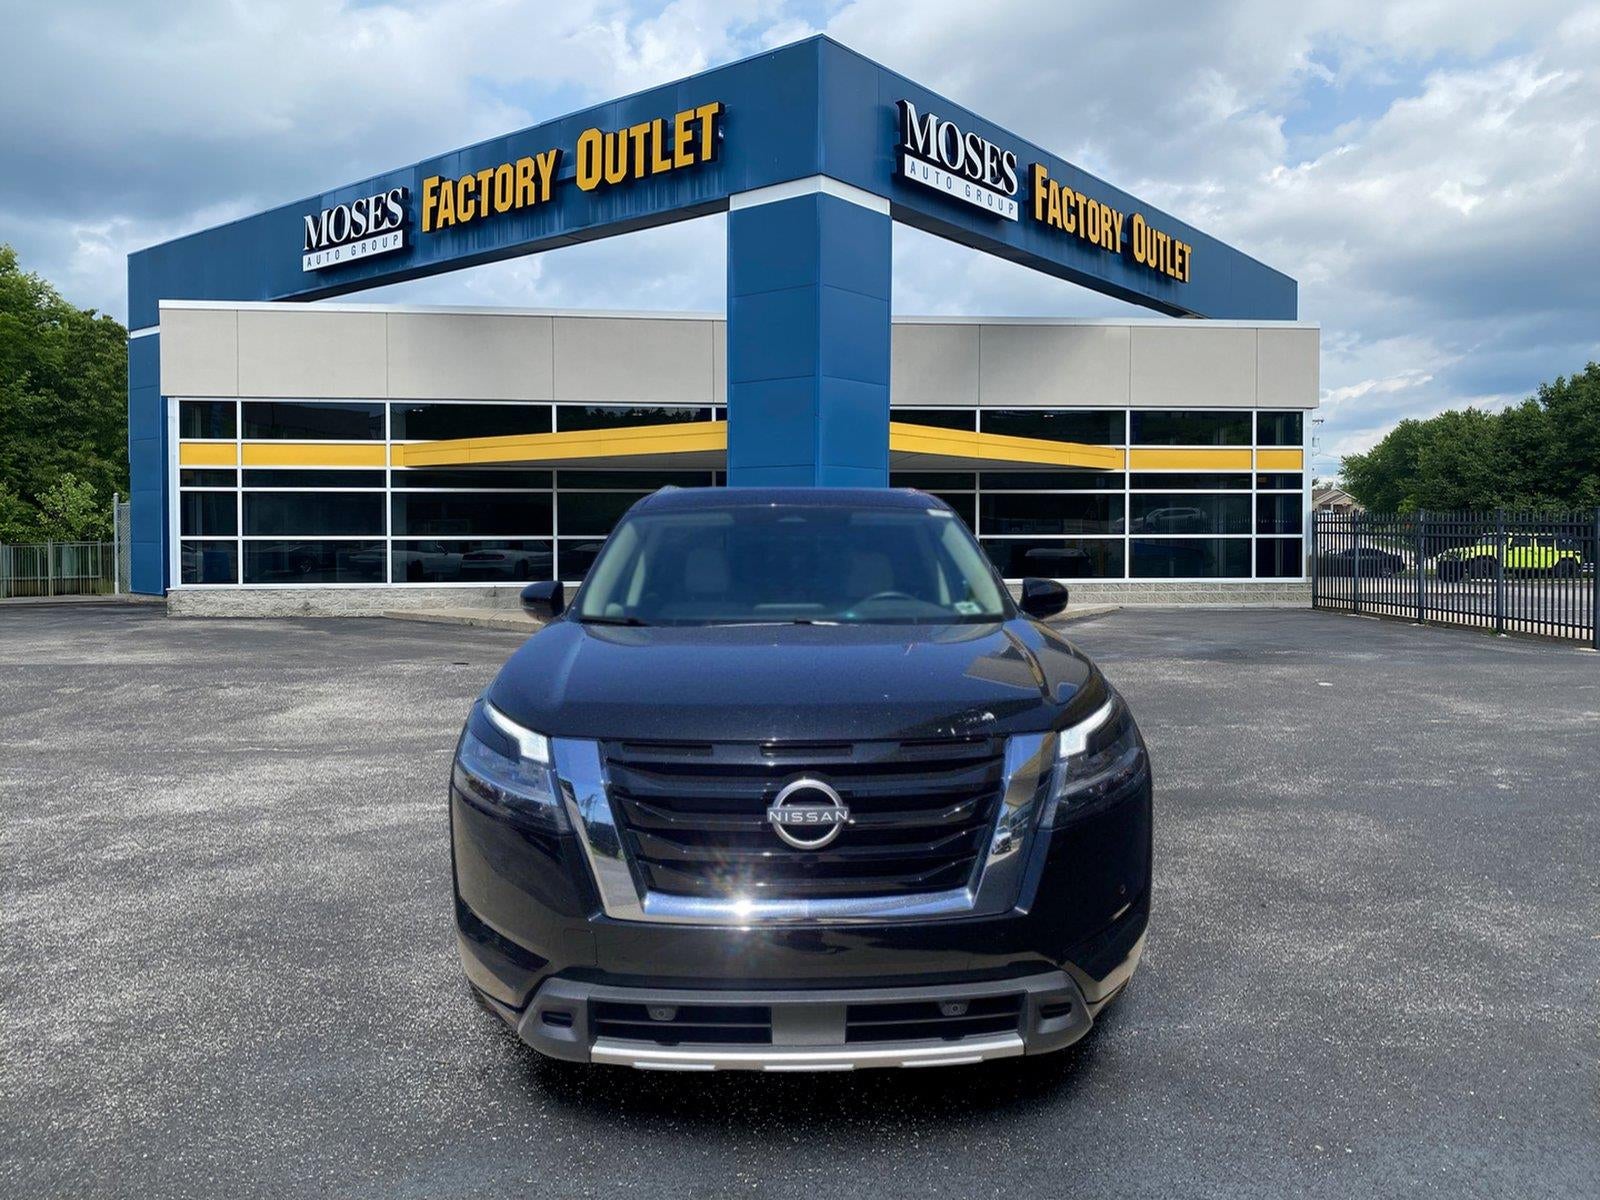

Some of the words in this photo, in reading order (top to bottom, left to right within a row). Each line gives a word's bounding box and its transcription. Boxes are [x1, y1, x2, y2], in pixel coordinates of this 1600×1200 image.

[421, 148, 559, 233] FACTORY
[576, 101, 721, 192] OUTLET
[903, 99, 1018, 196] MOSES
[303, 187, 403, 250] MOSES
[909, 160, 953, 191] AUTO
[964, 184, 1015, 215] GROUP
[306, 249, 342, 269] AUTO
[350, 233, 400, 257] GROUP
[1034, 162, 1124, 254] FACTORY
[1131, 212, 1193, 283] OUTLET
[769, 811, 848, 823] NISSAN
